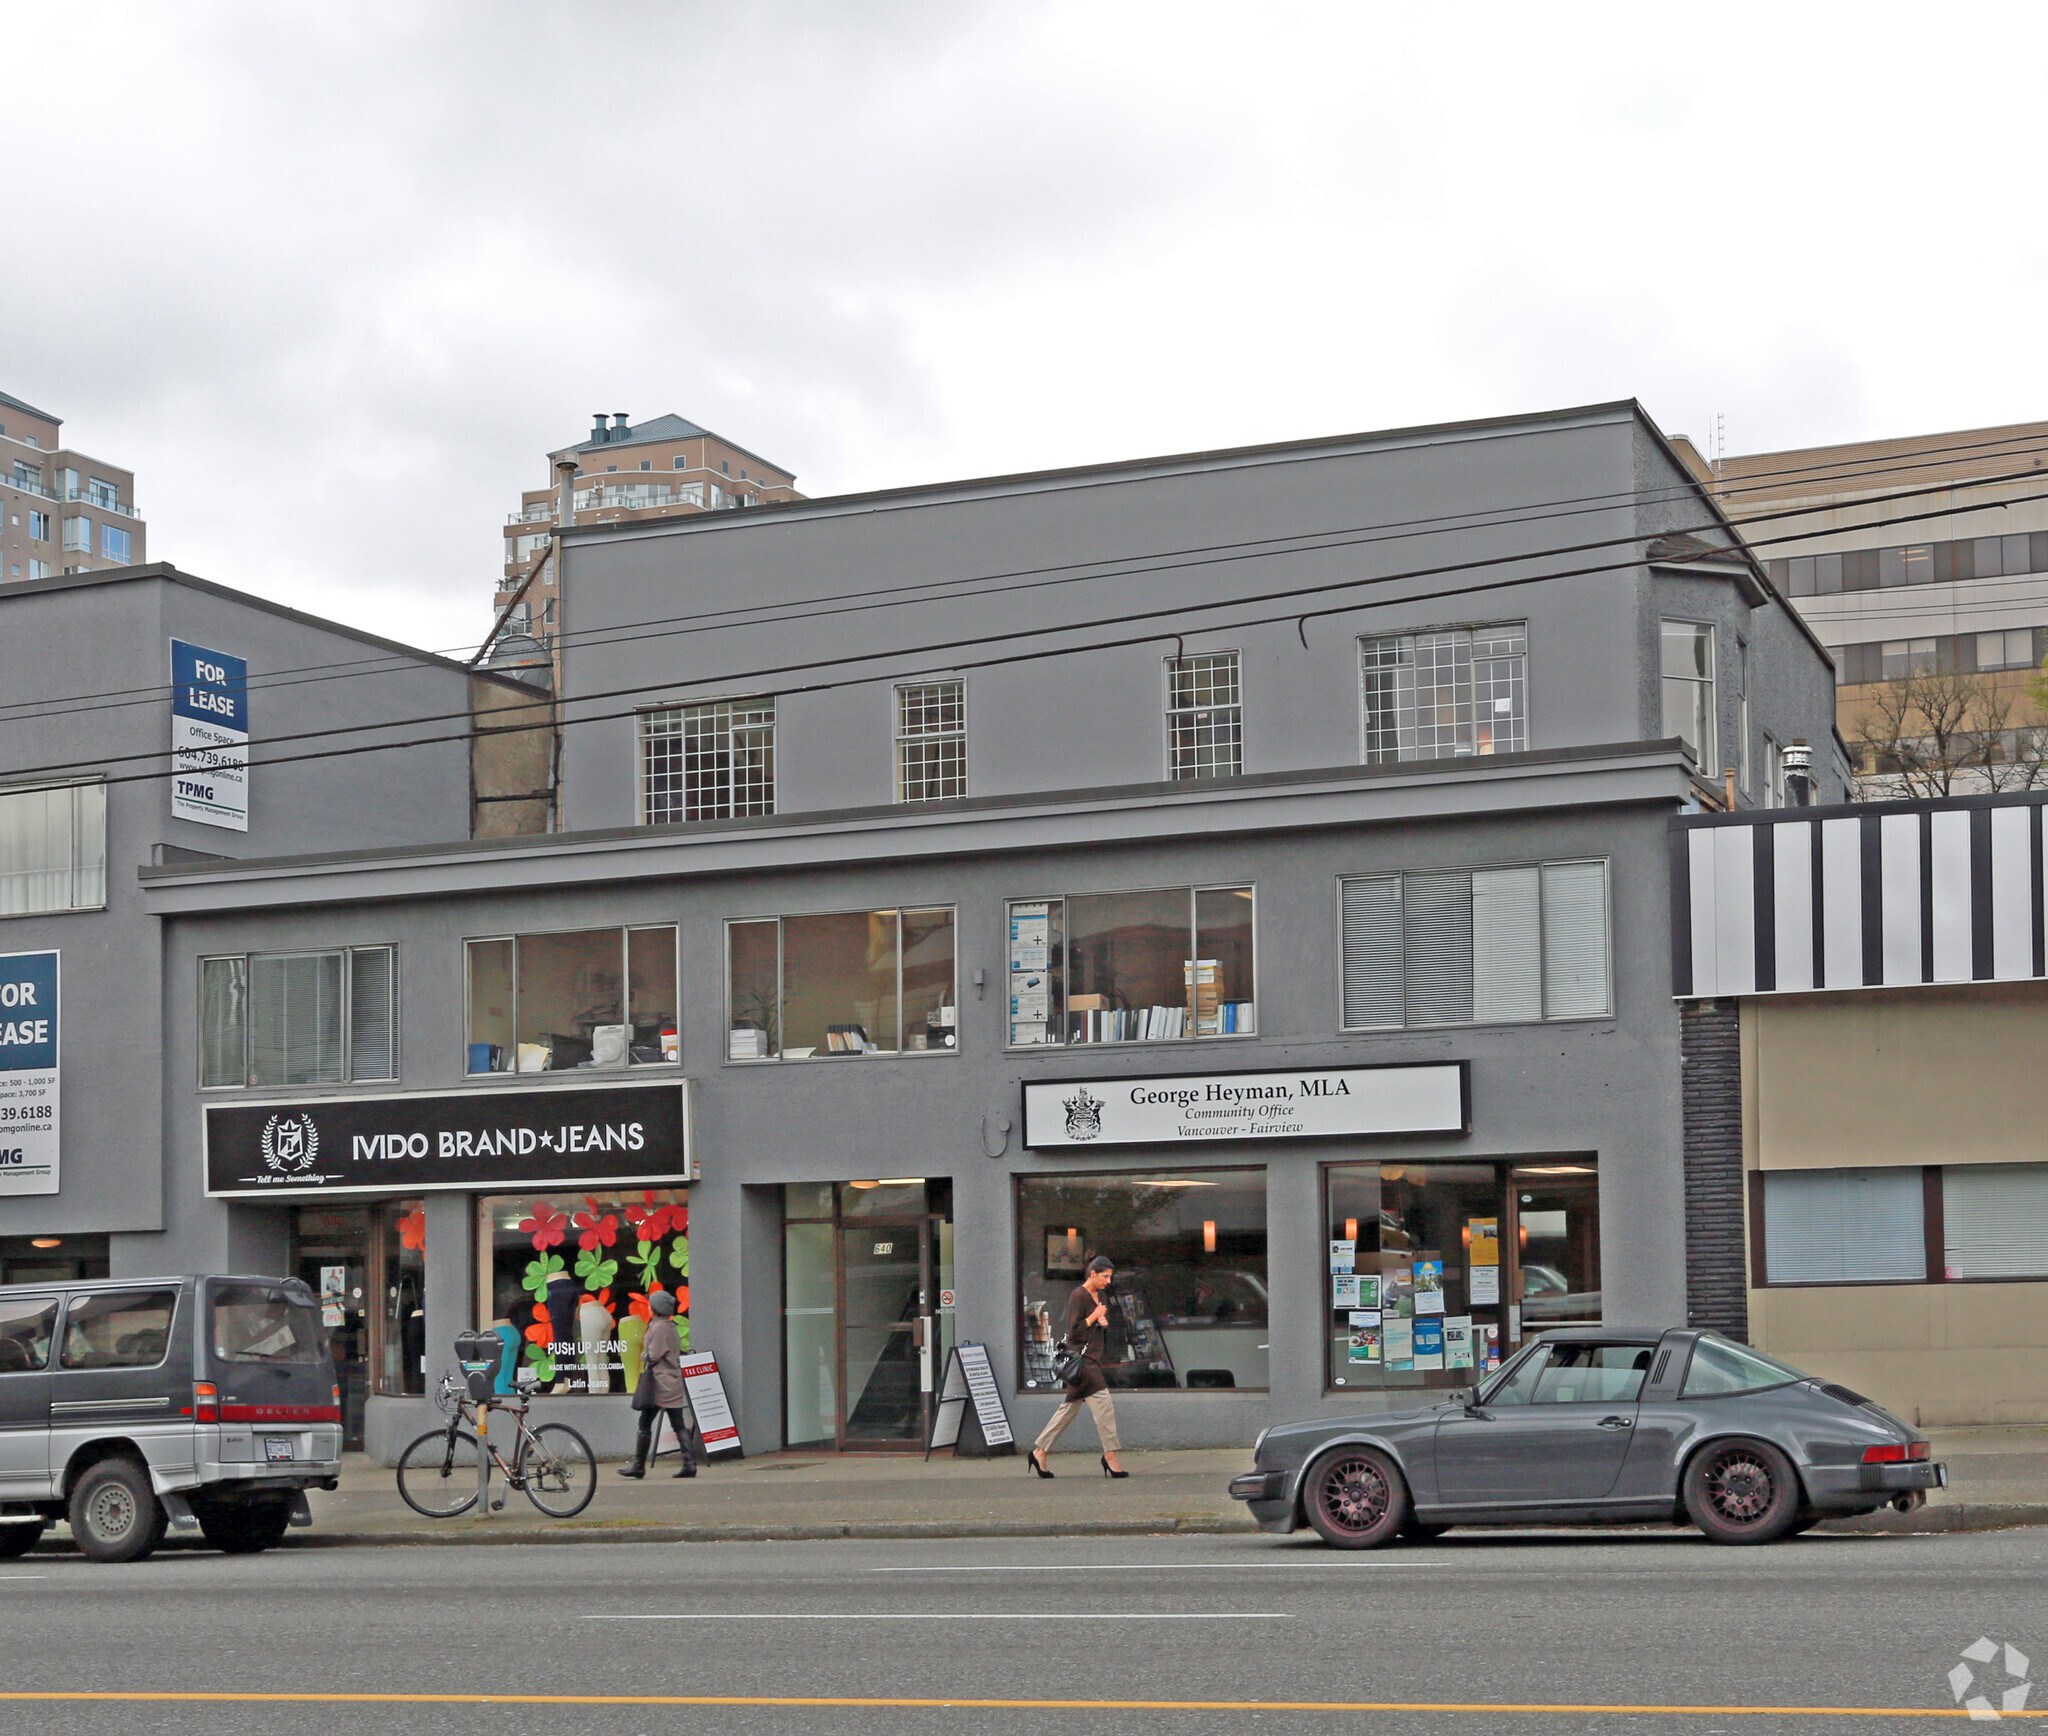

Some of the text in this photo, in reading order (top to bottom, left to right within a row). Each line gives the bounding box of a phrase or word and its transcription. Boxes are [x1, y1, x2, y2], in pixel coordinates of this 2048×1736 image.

[195, 659, 227, 686] FOR
[189, 687, 235, 718] LEASE
[189, 726, 235, 745] Office Space
[177, 780, 214, 801] TPMG
[177, 800, 244, 820] The Property Management Group
[0, 982, 37, 1008] OR
[9, 1079, 22, 1087] 500
[28, 1077, 46, 1087] 1,000
[18, 1089, 37, 1098] 3,700
[38, 1088, 46, 1096] SF
[1130, 1078, 1351, 1108] George Heyman, MLA
[1185, 1104, 1295, 1120] Community Office
[1177, 1125, 1238, 1137] Vancouver
[1250, 1122, 1304, 1134] Fairview
[352, 1122, 645, 1160] IVIDO BRAND JEANS
[36, 1169, 51, 1177] Group
[256, 1175, 272, 1184] Tell
[285, 1174, 325, 1185] Something
[874, 1243, 892, 1254] 640
[326, 1313, 342, 1322] OPEN
[547, 1339, 628, 1355] PUSH UP JEANS
[548, 1363, 563, 1371] MADE
[598, 1362, 625, 1370] COLOMBIA
[685, 1364, 714, 1376] TAX CLINIC
[568, 1378, 608, 1388] Latin Jeans
